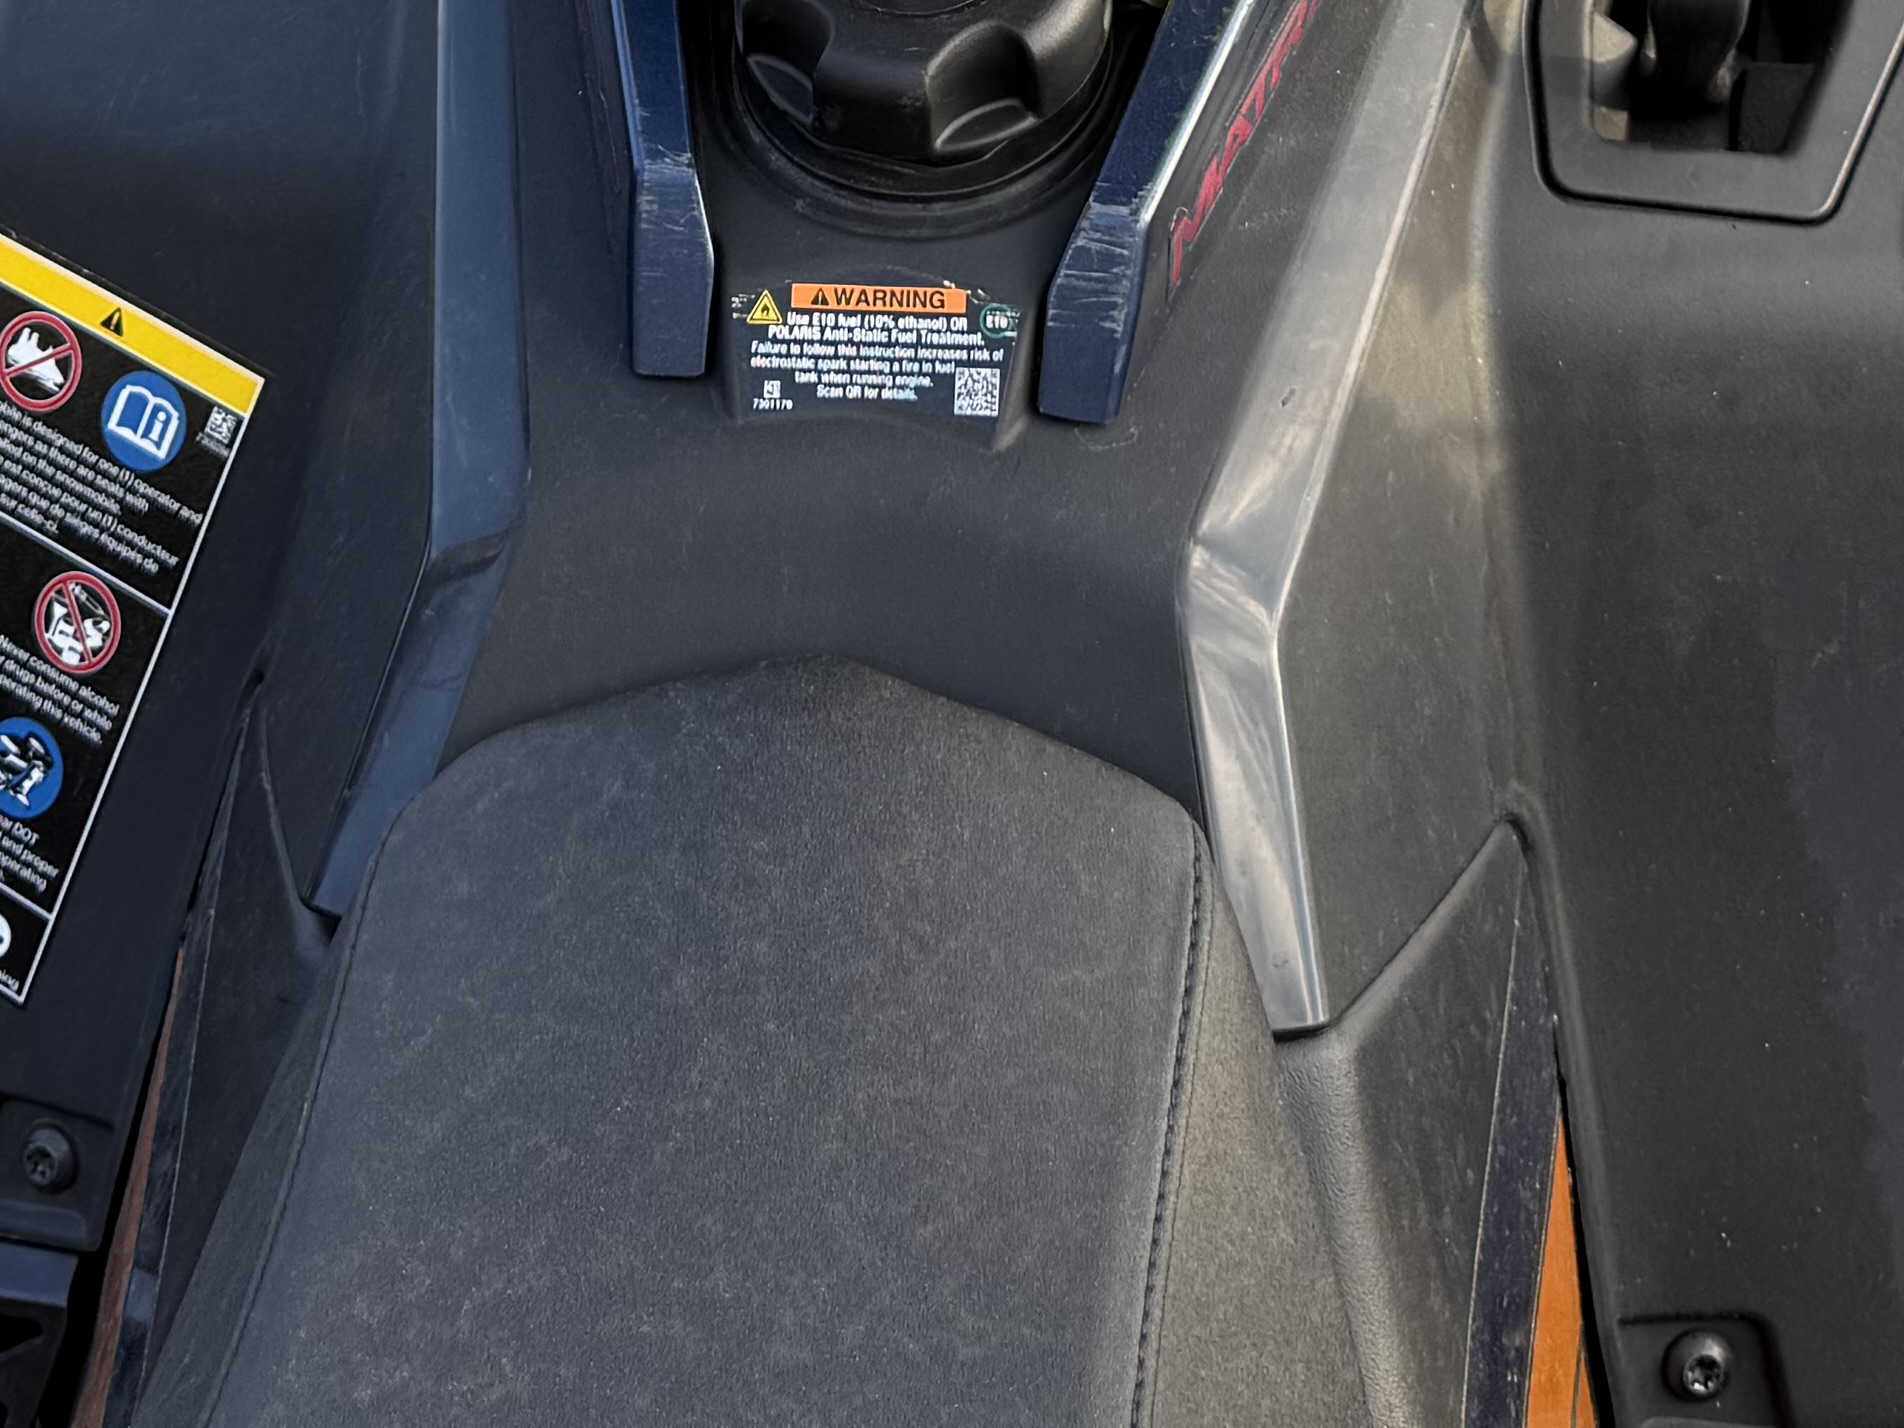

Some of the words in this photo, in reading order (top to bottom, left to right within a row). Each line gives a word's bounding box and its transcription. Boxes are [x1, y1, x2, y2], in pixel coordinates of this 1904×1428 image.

[834, 287, 945, 309] WARNING
[787, 312, 809, 326] Use
[812, 312, 835, 327] E10
[838, 312, 861, 327] fuel
[864, 314, 895, 329] (10%
[897, 315, 946, 331] ethanol)
[950, 316, 968, 331] OR
[768, 325, 821, 340] POLARIS
[823, 326, 889, 342] Anti-Static
[891, 328, 917, 343] Fuel
[920, 329, 985, 346] Treatment.
[751, 340, 788, 354] Failure
[790, 342, 801, 354] to
[803, 342, 835, 356] follow
[837, 343, 857, 356] this
[859, 344, 915, 359] instruction
[916, 345, 968, 360] increases
[970, 346, 990, 361] risk
[992, 348, 1004, 362] of
[750, 355, 815, 369] electrostatic
[817, 357, 847, 371] spark
[850, 358, 890, 374] starting
[892, 361, 900, 373] a
[902, 359, 920, 373] fire
[922, 360, 933, 373] in
[935, 360, 955, 374] fuel
[794, 371, 818, 384] tank
[820, 371, 850, 385] when
[852, 372, 893, 387] running
[895, 374, 934, 388] engine.
[816, 384, 844, 398] Scan
[845, 385, 862, 399] QR
[864, 386, 879, 399] for
[32, 421, 83, 454] designed
[133, 478, 180, 510] operator
[48, 446, 77, 470] there
[94, 474, 124, 497] seats
[116, 524, 178, 565] conducteur
[3, 659, 35, 683] drugs
[34, 675, 71, 705] before
[83, 706, 112, 730] while
[27, 656, 79, 691] consume
[78, 685, 119, 715] alcohol
[11, 821, 39, 844] DOT
[20, 849, 58, 877] proper
